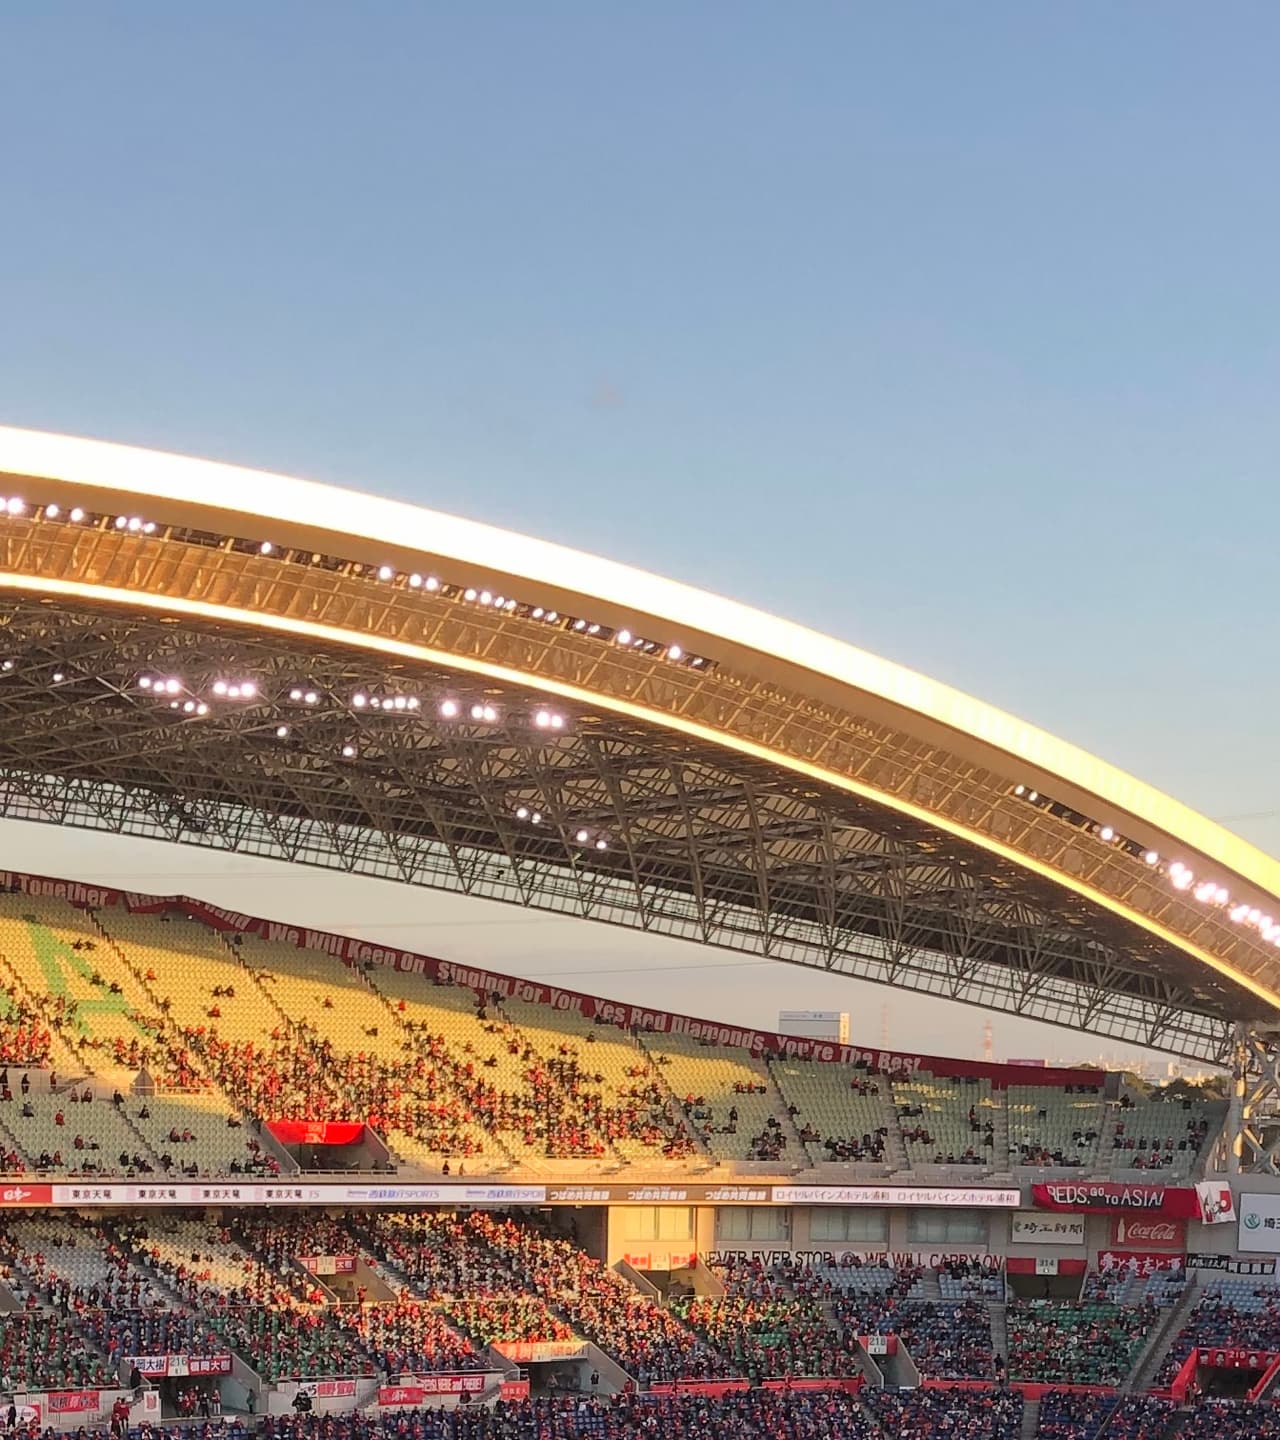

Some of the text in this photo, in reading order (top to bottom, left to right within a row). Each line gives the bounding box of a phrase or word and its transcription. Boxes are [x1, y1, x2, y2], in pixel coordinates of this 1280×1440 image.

[20, 874, 108, 907] Together
[269, 922, 298, 946] We
[305, 928, 344, 953] Will
[401, 949, 425, 974] On
[436, 961, 509, 998] Singing
[512, 976, 543, 1003] For
[593, 998, 626, 1024] Yes
[629, 1006, 666, 1032] Red
[877, 1051, 921, 1075] Best
[751, 1251, 788, 1267] EVER
[865, 1252, 888, 1266] WE
[892, 1252, 924, 1268] WILL
[983, 1255, 1003, 1269] ON
